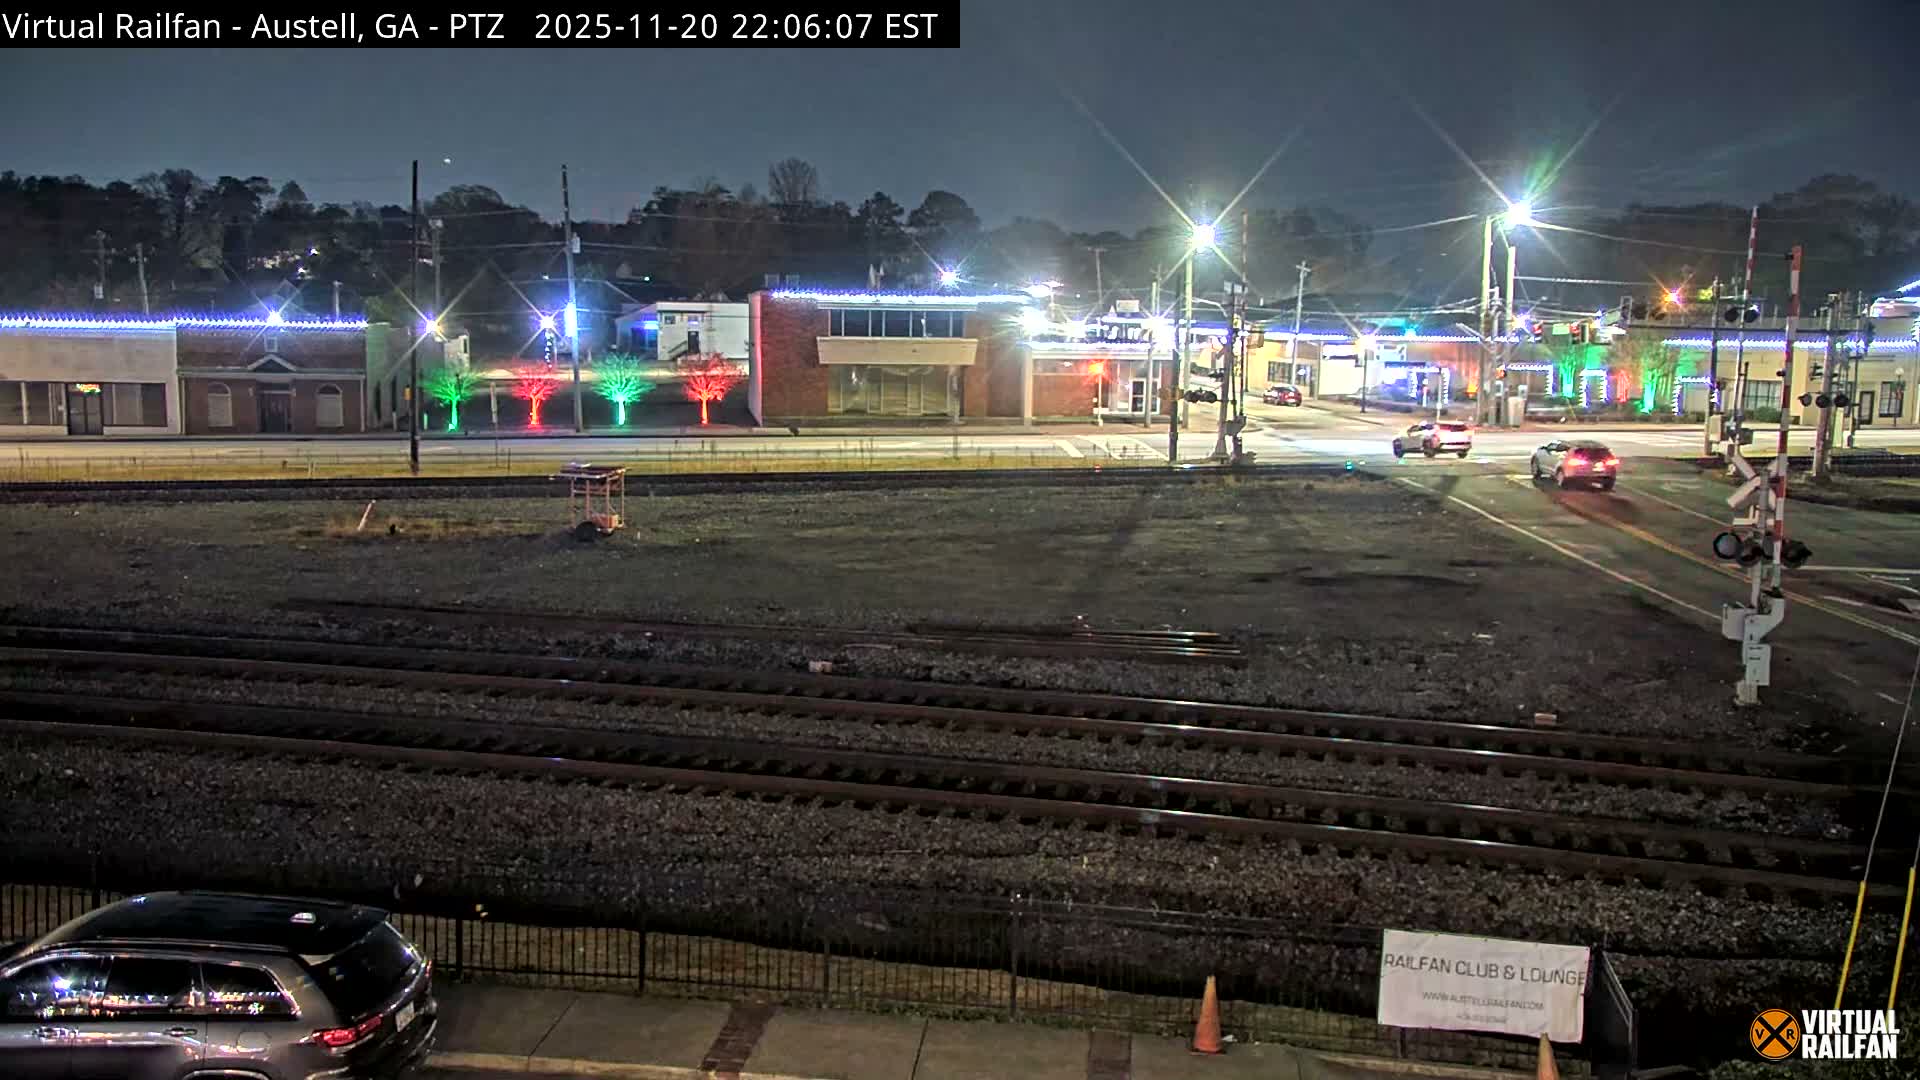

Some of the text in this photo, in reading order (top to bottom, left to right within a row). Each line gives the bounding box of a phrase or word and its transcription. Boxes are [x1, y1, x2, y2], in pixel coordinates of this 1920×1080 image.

[1384, 953, 1587, 986] RAILFAN CLUB & LOUNGE
